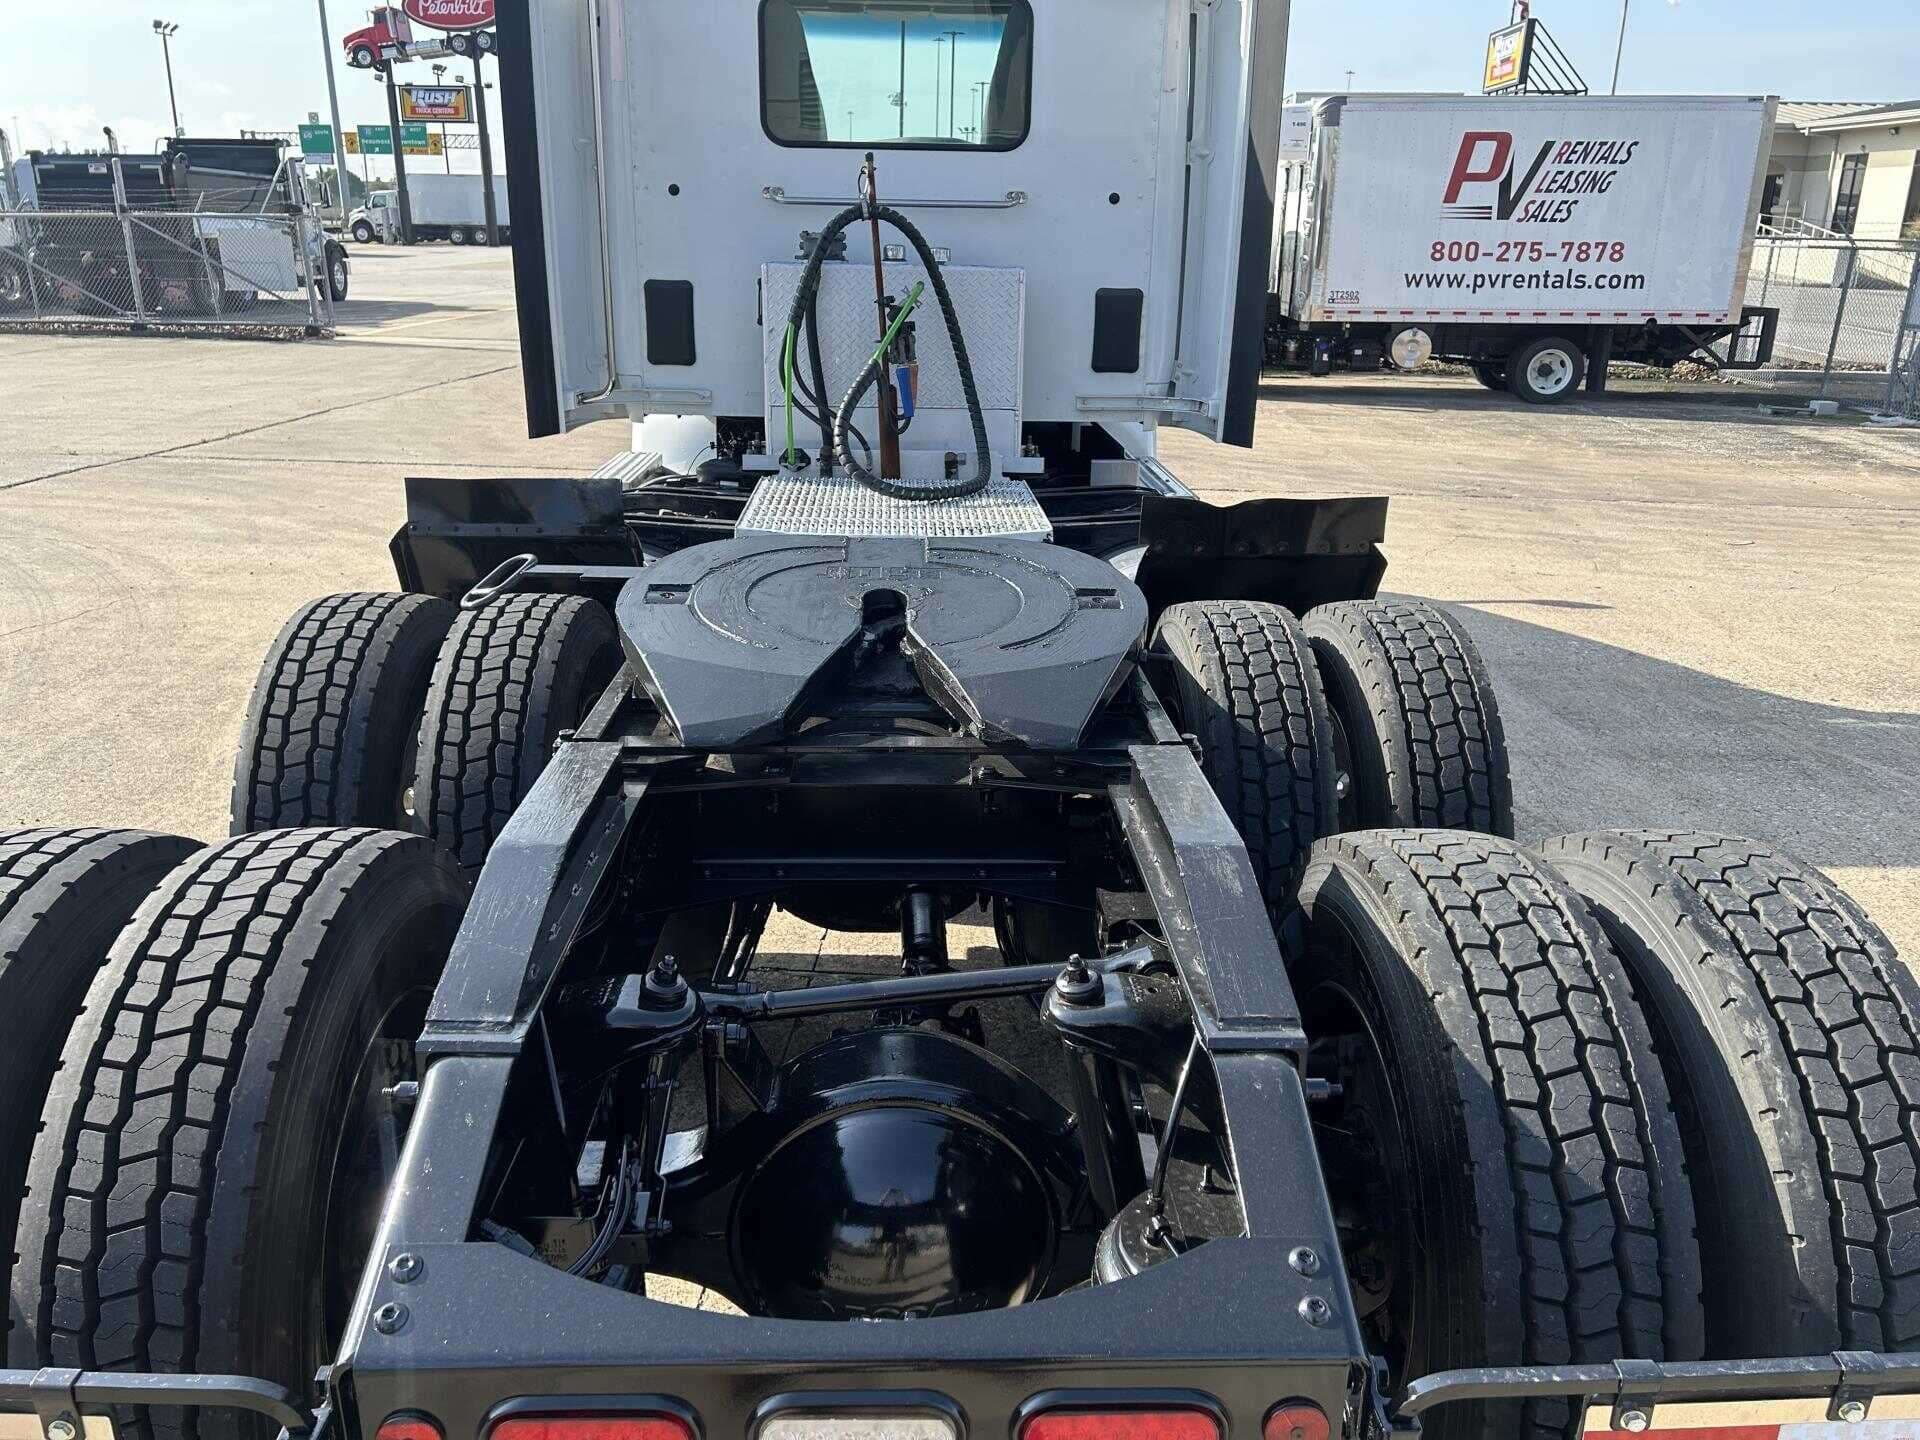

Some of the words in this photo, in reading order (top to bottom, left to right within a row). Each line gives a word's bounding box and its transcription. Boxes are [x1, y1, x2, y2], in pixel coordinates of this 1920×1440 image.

[418, 0, 486, 17] Peterbilt
[410, 90, 457, 107] RUSH
[1551, 140, 1640, 165] RENTALS
[1443, 131, 1556, 221] PV
[1534, 170, 1618, 194] LEASING
[1516, 199, 1579, 223] SALES
[1430, 240, 1625, 263] 800-275-7878
[1404, 268, 1646, 294] www.pvrentals.com
[1329, 290, 1360, 299] 3T2502
